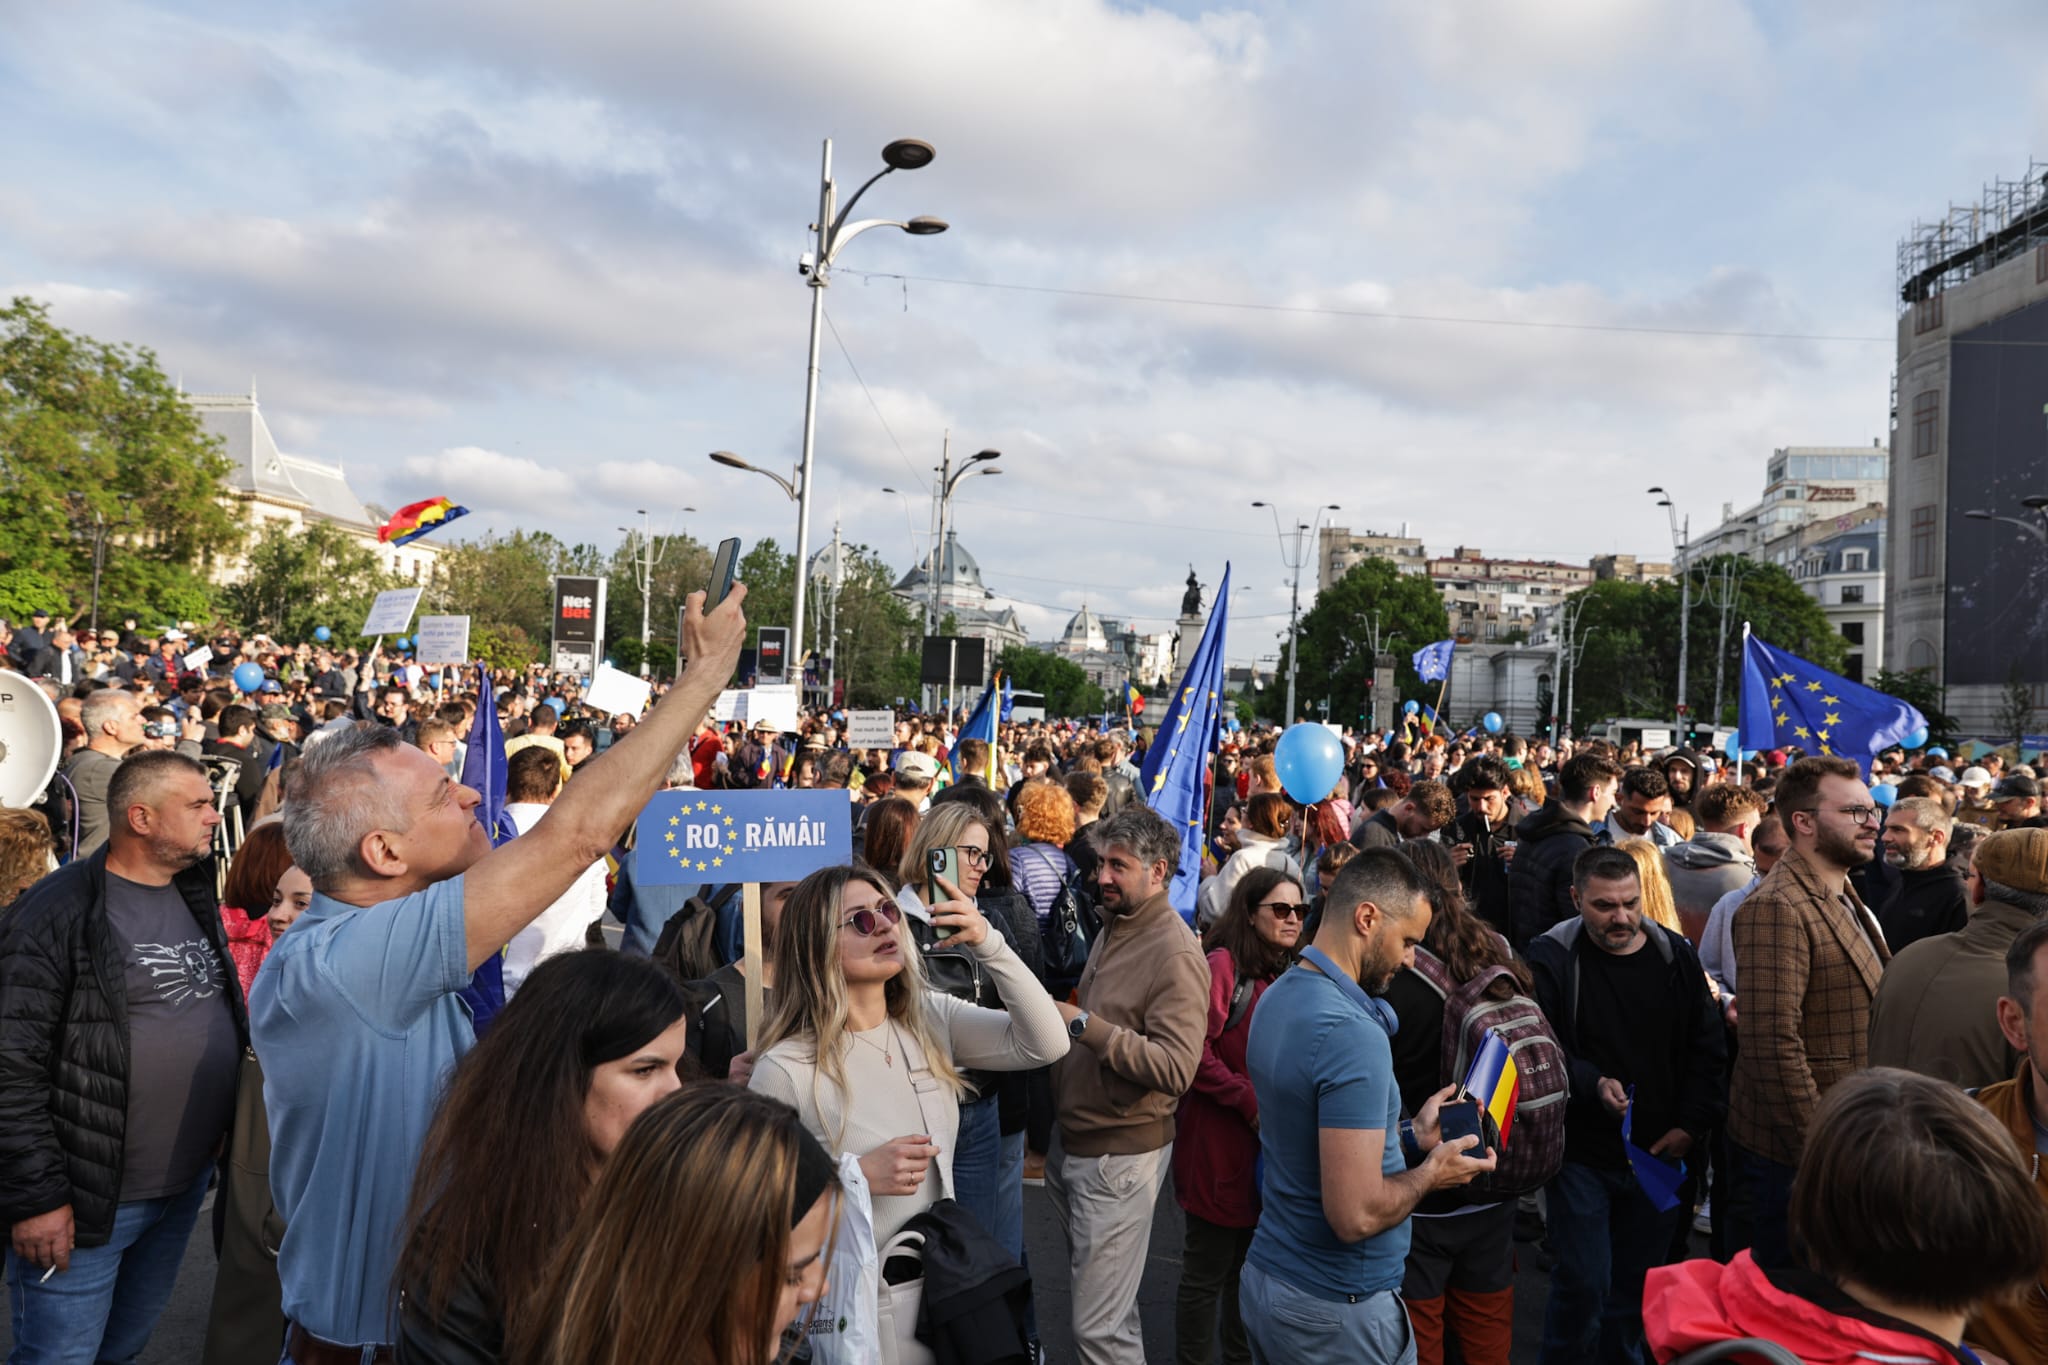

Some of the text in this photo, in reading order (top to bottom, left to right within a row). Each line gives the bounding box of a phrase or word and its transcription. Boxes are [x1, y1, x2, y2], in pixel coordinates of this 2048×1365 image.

[562, 595, 591, 608] Net
[562, 607, 591, 619] Bet
[762, 641, 781, 649] Net
[686, 815, 826, 850] RO, RĂMÂI!
